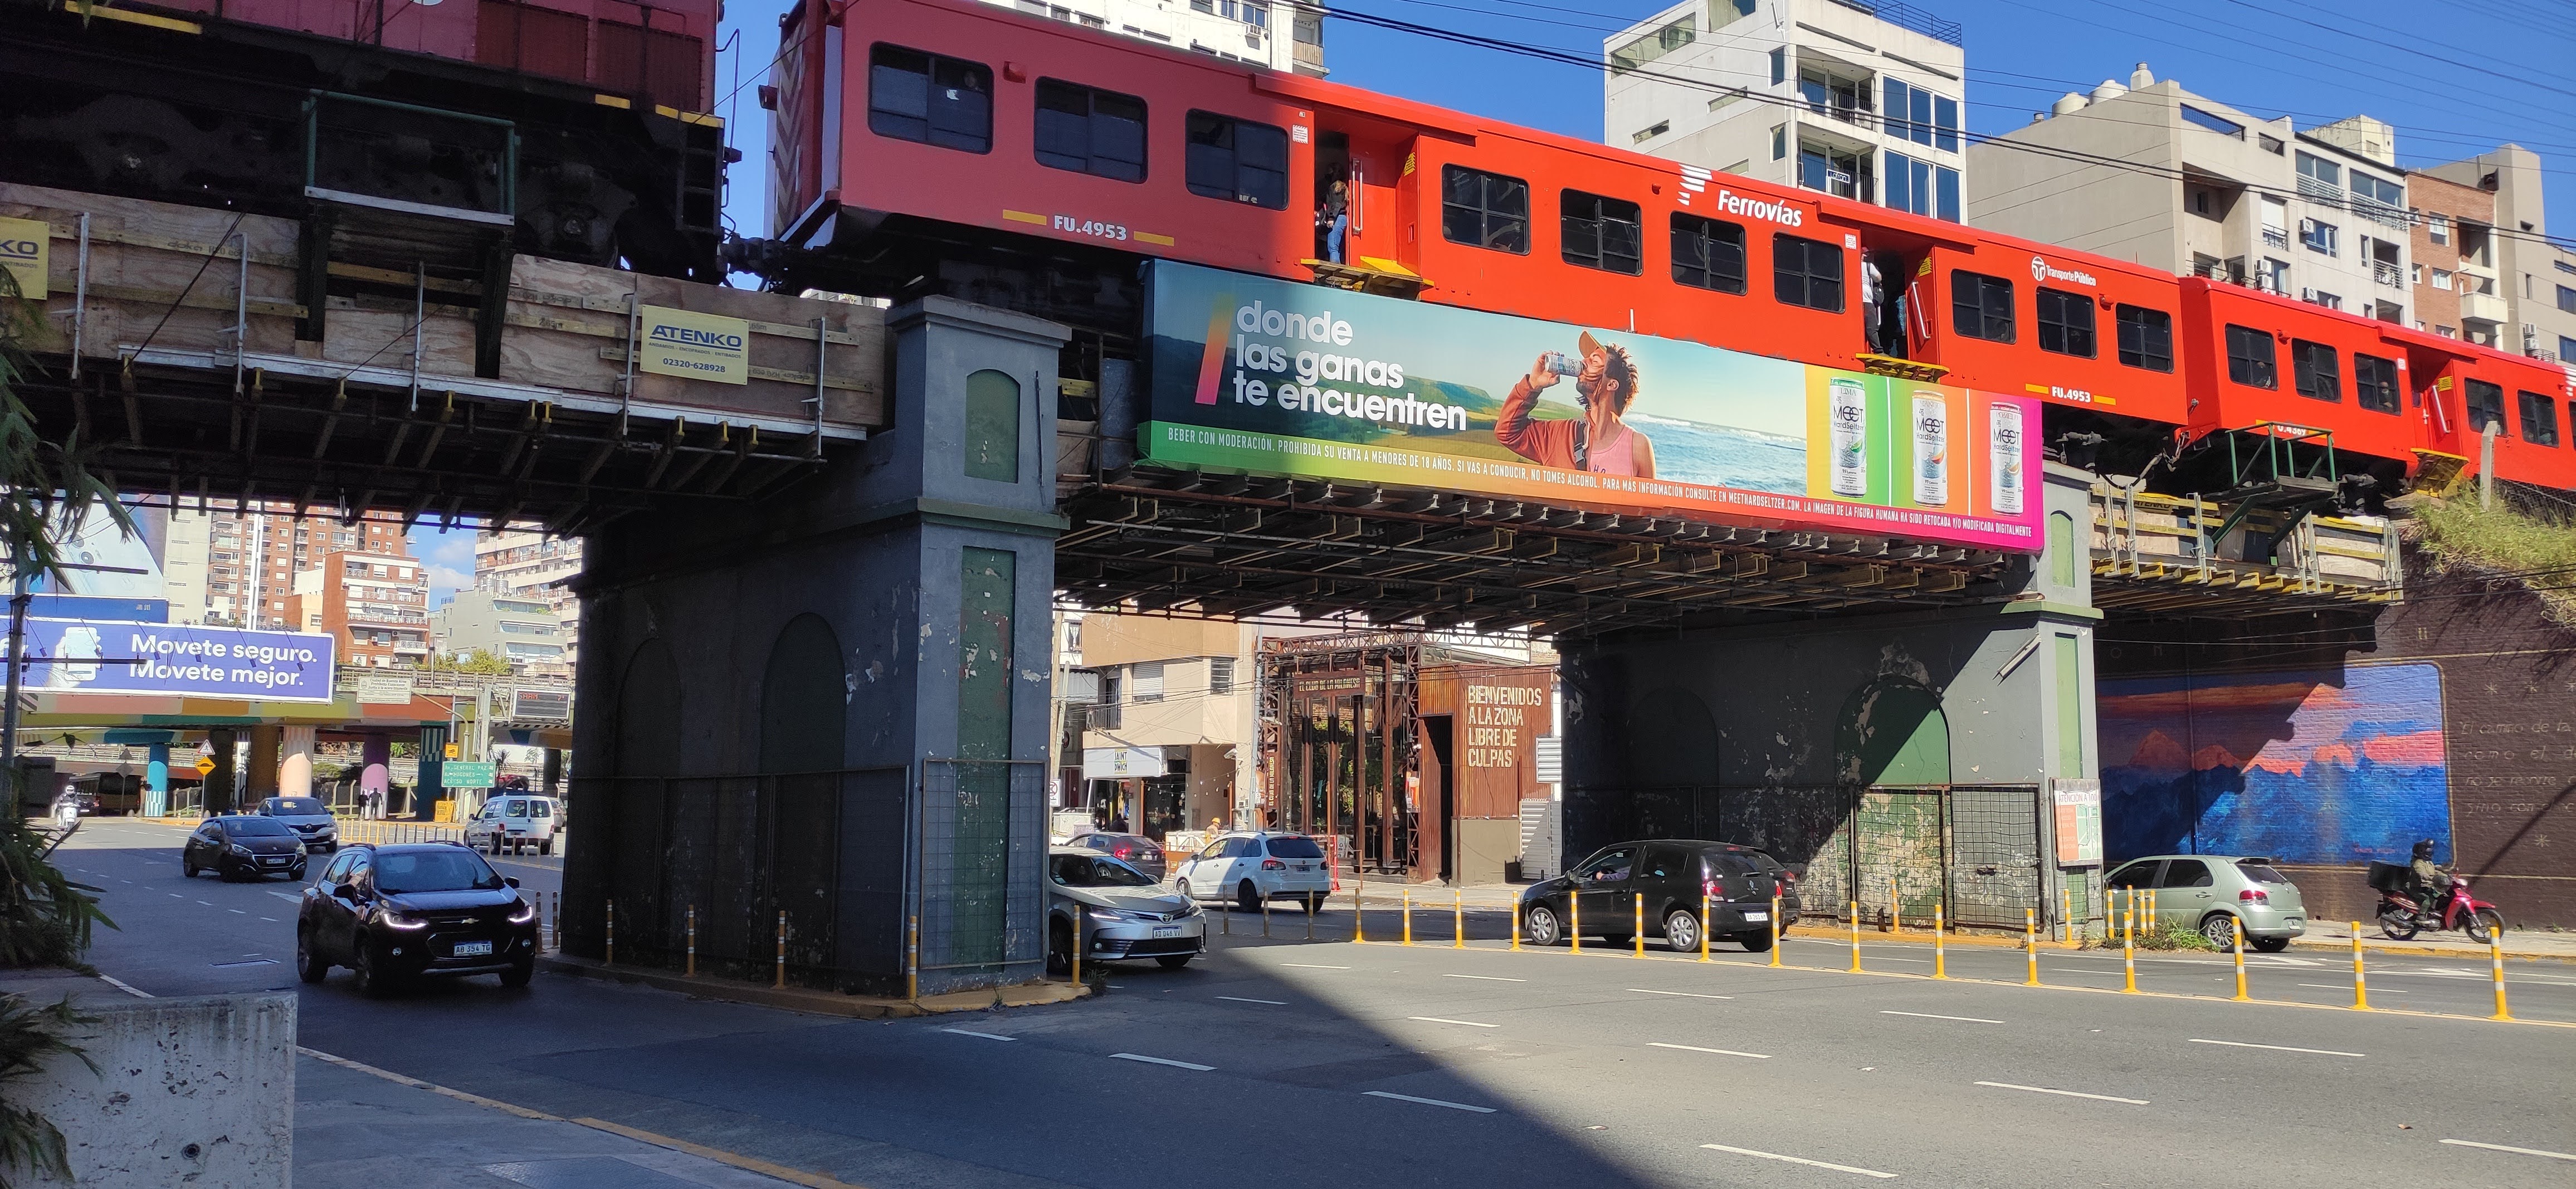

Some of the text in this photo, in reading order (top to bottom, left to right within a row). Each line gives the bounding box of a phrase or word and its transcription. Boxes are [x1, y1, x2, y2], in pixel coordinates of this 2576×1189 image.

[1718, 189, 1802, 227] Ferrovías
[1054, 215, 1126, 240] FU.4953
[2046, 265, 2096, 286] Transporte Público
[1237, 300, 1353, 346] donde
[651, 325, 741, 348] ATENKO
[663, 358, 725, 373] 02320-628928
[1236, 334, 1404, 389] las ganas
[1233, 370, 1466, 431] te encuentren
[1840, 387, 1857, 396] LIMA
[2052, 386, 2091, 403] FU.4953
[1168, 427, 2032, 538] BEBER CON MODERACIÓN. PROHIBIDA SU VENTA A MENORES DE 18 AÑOS. SI VAS A CONDUCIR, NO TOMES ALCOHOL. PARA MÁS INFORMACIÓN CONSULTE EN MEETHARDSELTZER.COM. LA IMAGEN DE LA FIGURA HUMANA HA SIDO RETOCADA Y/O MODIFICADA DIGITALMENTE
[131, 634, 318, 666] Movete seguro.
[129, 664, 304, 689] Movete mejor.
[1299, 678, 1360, 691] EL CLUB DE LA MILANESA
[1468, 685, 1542, 706] BIENVENIDOS
[1468, 706, 1524, 727] A LA ZONA
[2531, 719, 2550, 733] de
[1468, 727, 1517, 747] LIBRE DE
[1115, 752, 1128, 761] SAINT
[1468, 748, 1513, 768] CULPAS
[2530, 745, 2546, 759] el
[2058, 793, 2083, 802] ATENCIÓN
